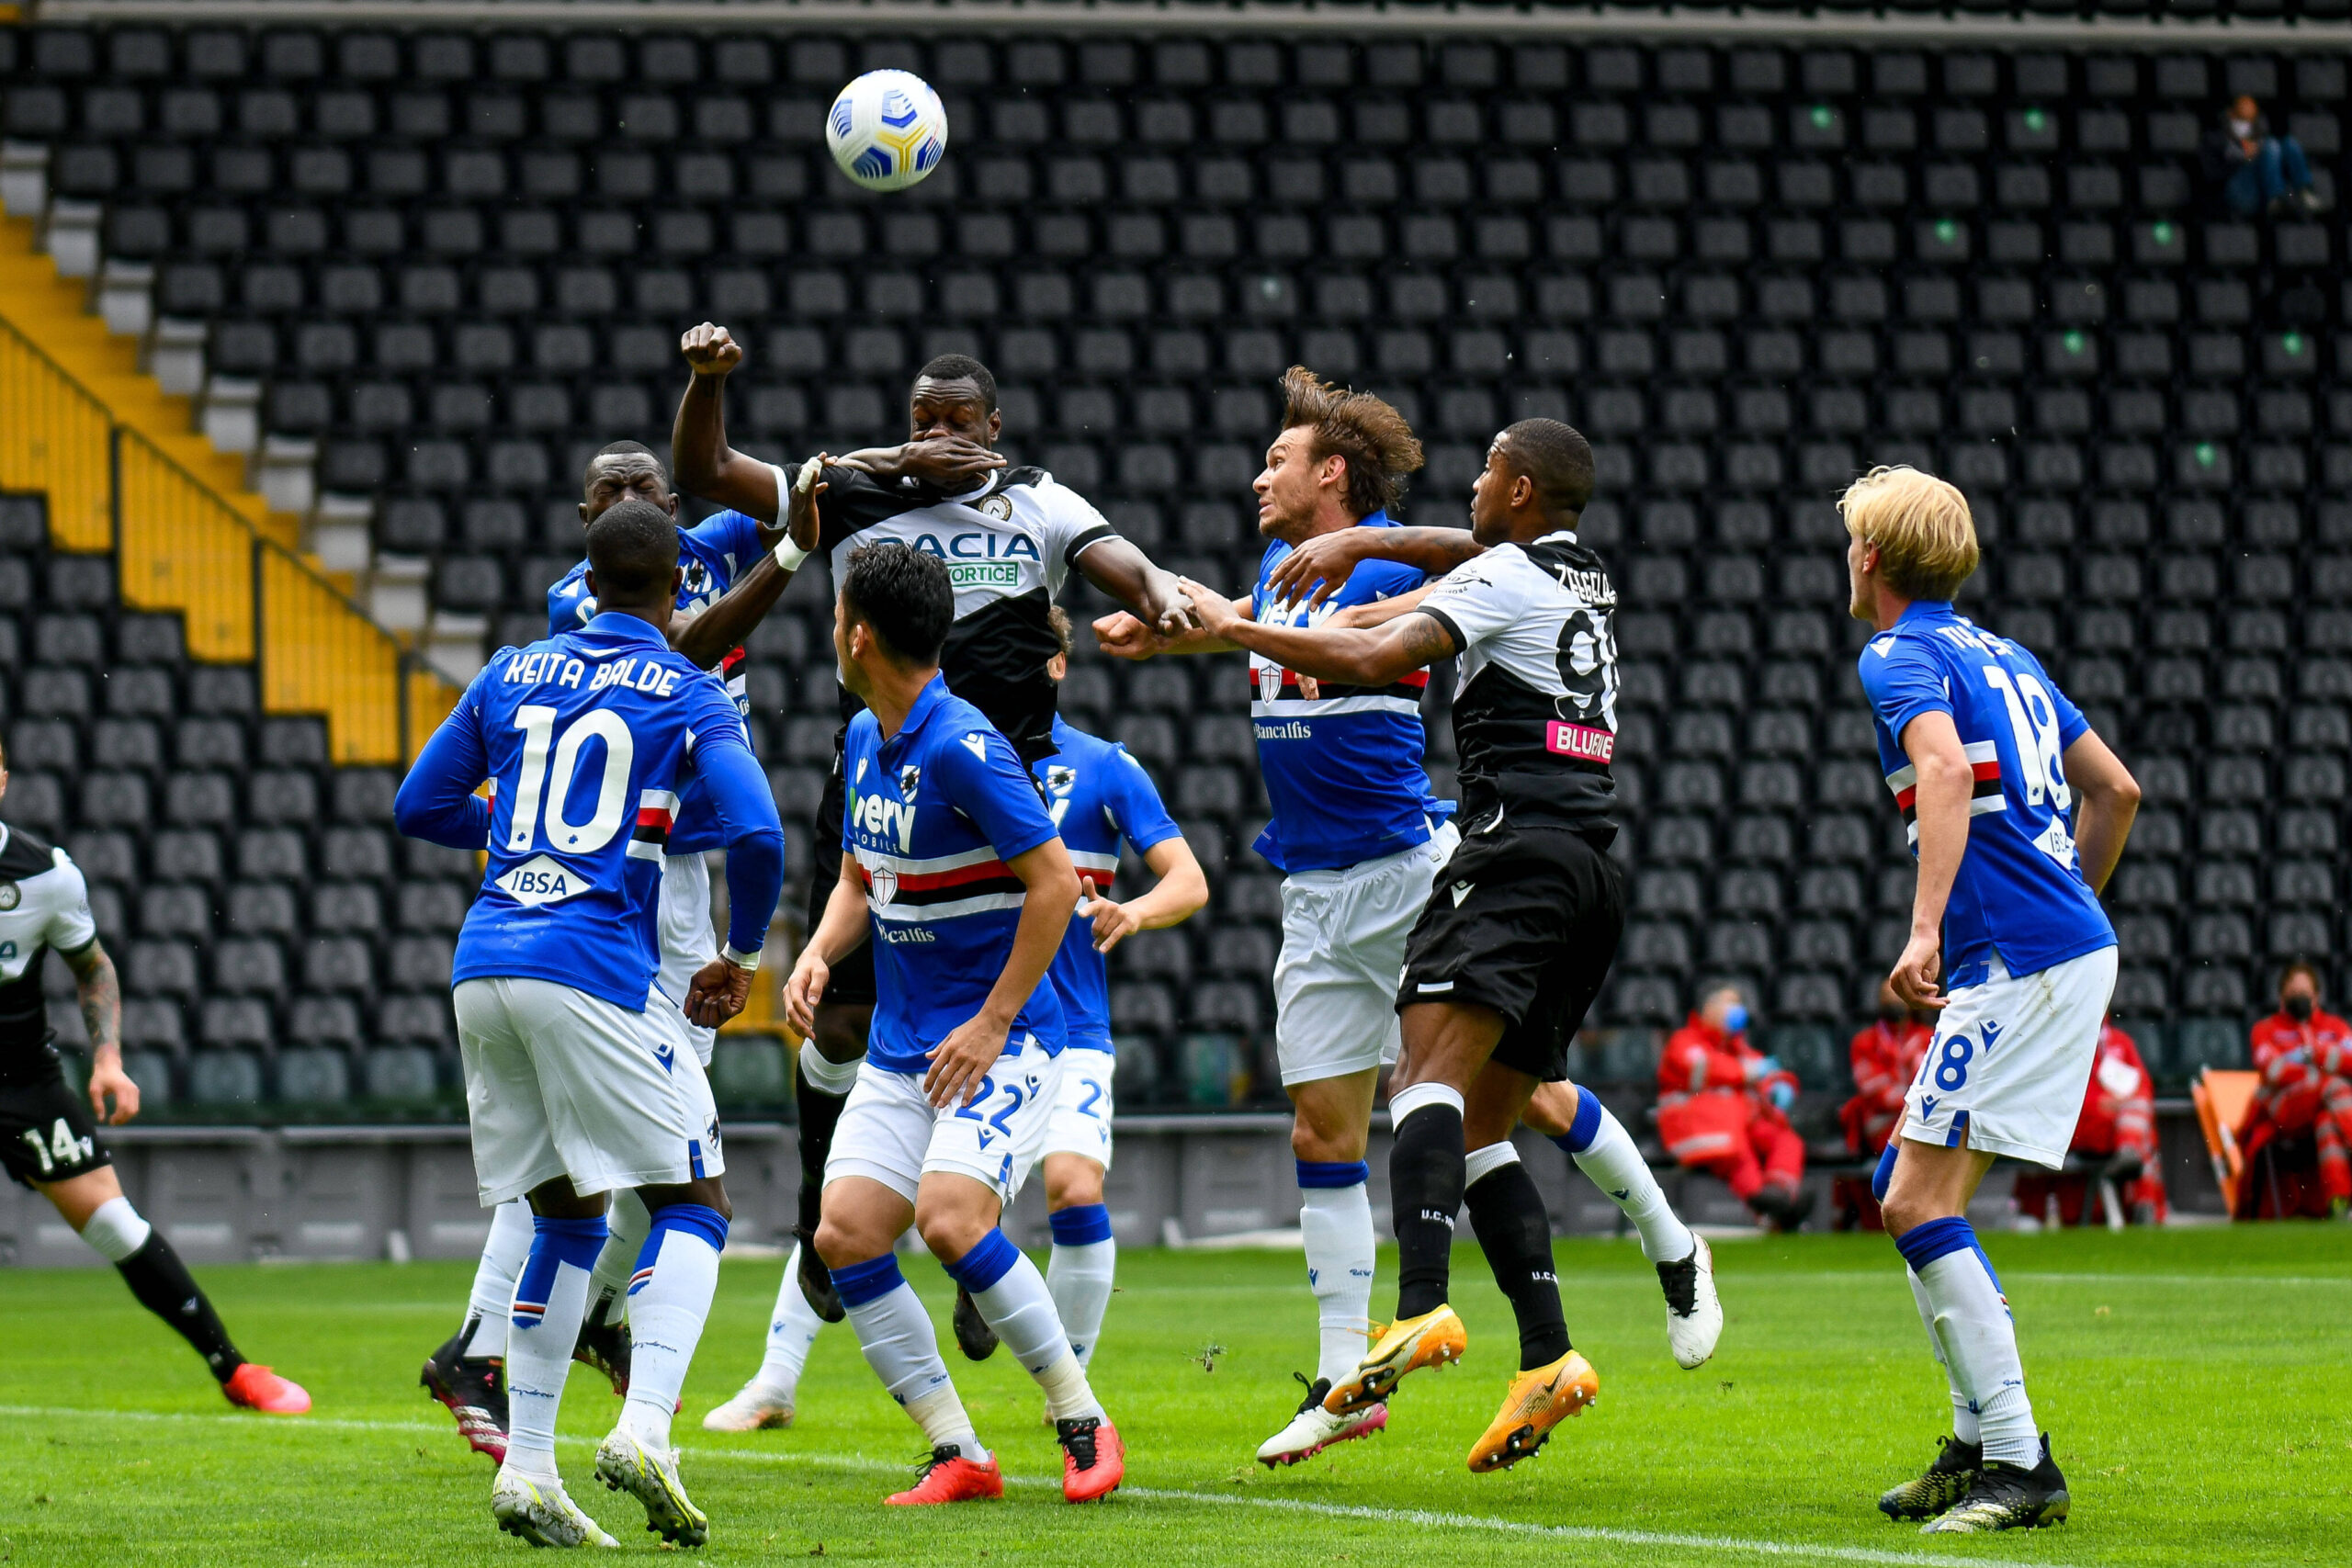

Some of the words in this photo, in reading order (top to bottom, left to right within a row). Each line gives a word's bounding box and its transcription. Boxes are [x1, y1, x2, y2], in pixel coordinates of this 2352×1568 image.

[949, 566, 1015, 582] ORTICE
[503, 651, 585, 690] KEITA
[588, 658, 682, 697] BALDE
[1982, 665, 2072, 810] 18
[506, 705, 634, 854] 10
[511, 870, 568, 897] IBSA
[1918, 1031, 1973, 1092] 18
[955, 1074, 1023, 1138] 22
[24, 1118, 82, 1174] 14
